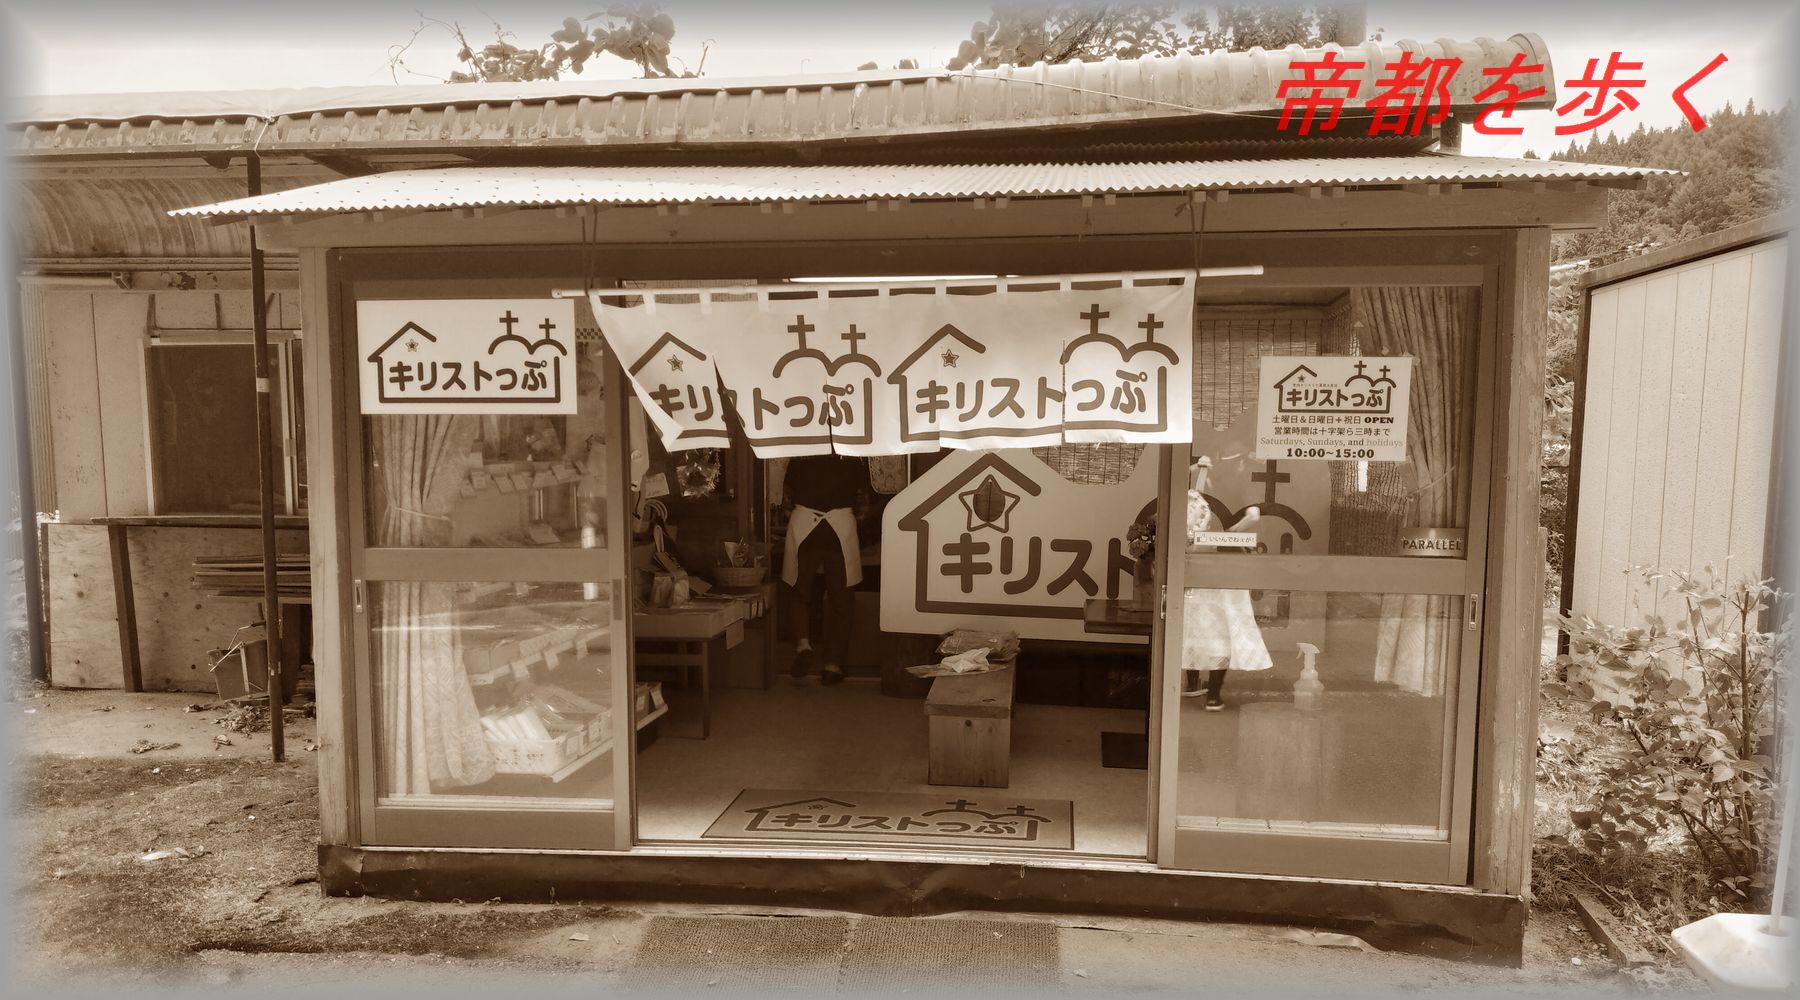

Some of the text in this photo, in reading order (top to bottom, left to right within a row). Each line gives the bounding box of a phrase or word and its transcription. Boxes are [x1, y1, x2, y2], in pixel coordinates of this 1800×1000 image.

[389, 360, 548, 391] キリストっぷ
[916, 370, 1148, 423] キリストっぷ
[1286, 388, 1384, 407] キリストっぷ
[1364, 416, 1394, 424] OPEN
[1274, 427, 1391, 436] 営業時間は十字架ら三時まで
[1260, 437, 1404, 448] Saturdays, Sundays, and holidays
[1402, 539, 1462, 550] PARALLEL
[771, 812, 1020, 834] キリストっぷ
